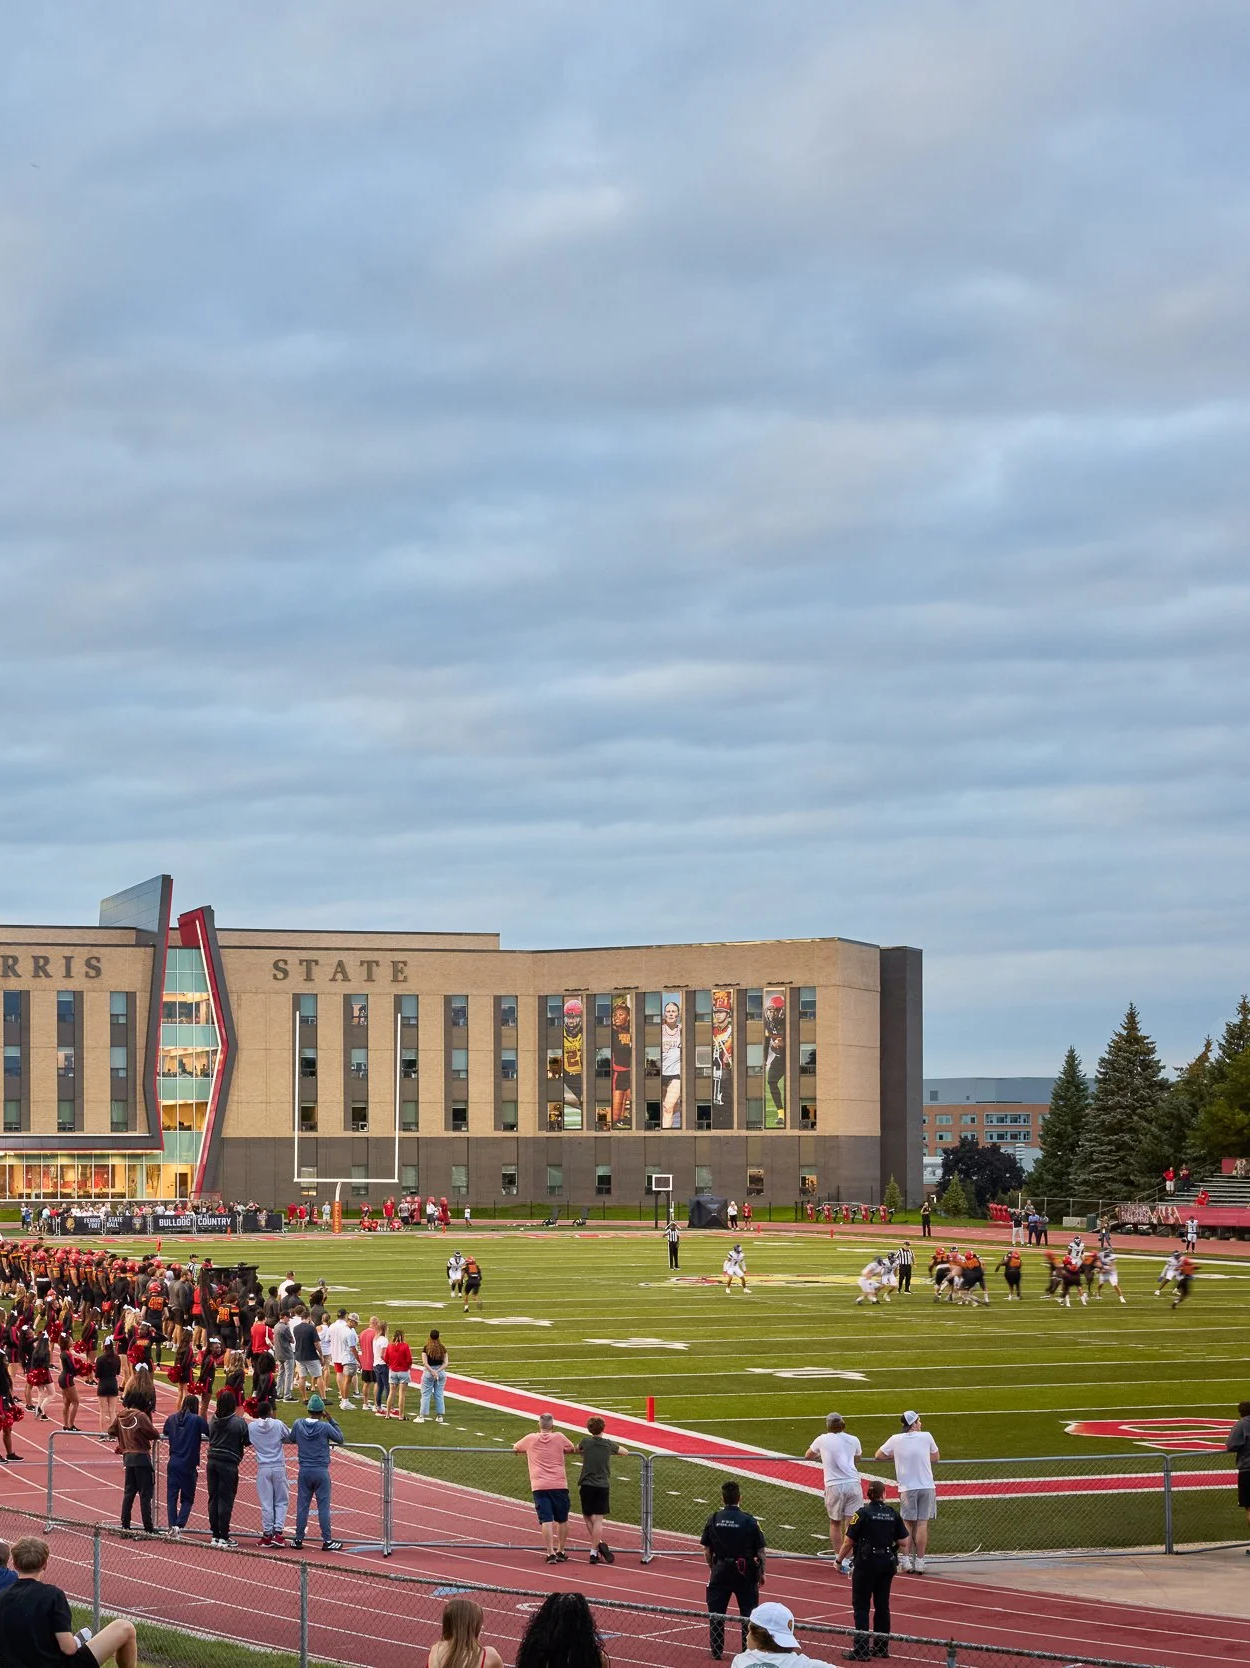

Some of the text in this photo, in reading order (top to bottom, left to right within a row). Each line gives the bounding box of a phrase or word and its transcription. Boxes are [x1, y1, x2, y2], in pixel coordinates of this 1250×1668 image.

[272, 958, 409, 983] STATE
[159, 1218, 191, 1227] BULLDOG
[197, 1217, 231, 1226] COUNTRY
